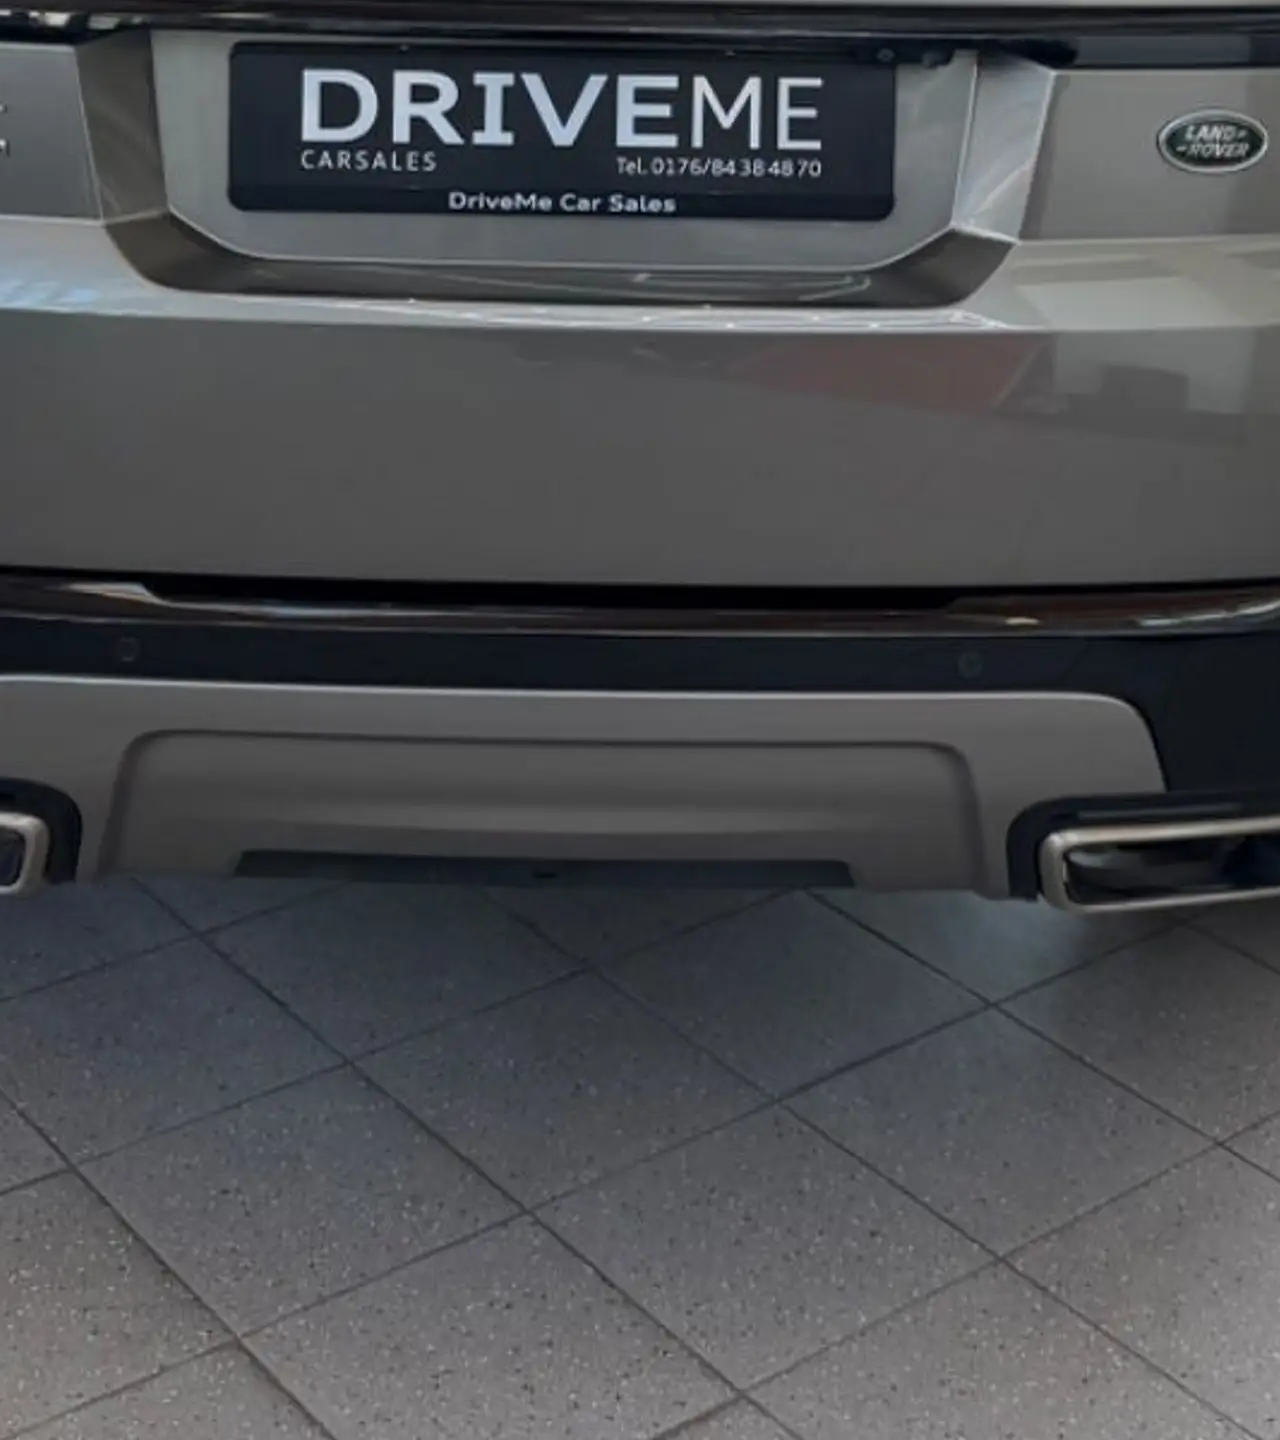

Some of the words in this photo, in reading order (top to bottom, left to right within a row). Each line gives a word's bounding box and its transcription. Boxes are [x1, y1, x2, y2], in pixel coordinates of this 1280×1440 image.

[300, 68, 823, 150] DRIVEME
[300, 149, 438, 173] CARSALES
[448, 191, 553, 211] DriveMe
[559, 193, 602, 213] Car
[608, 193, 677, 214] Sales
